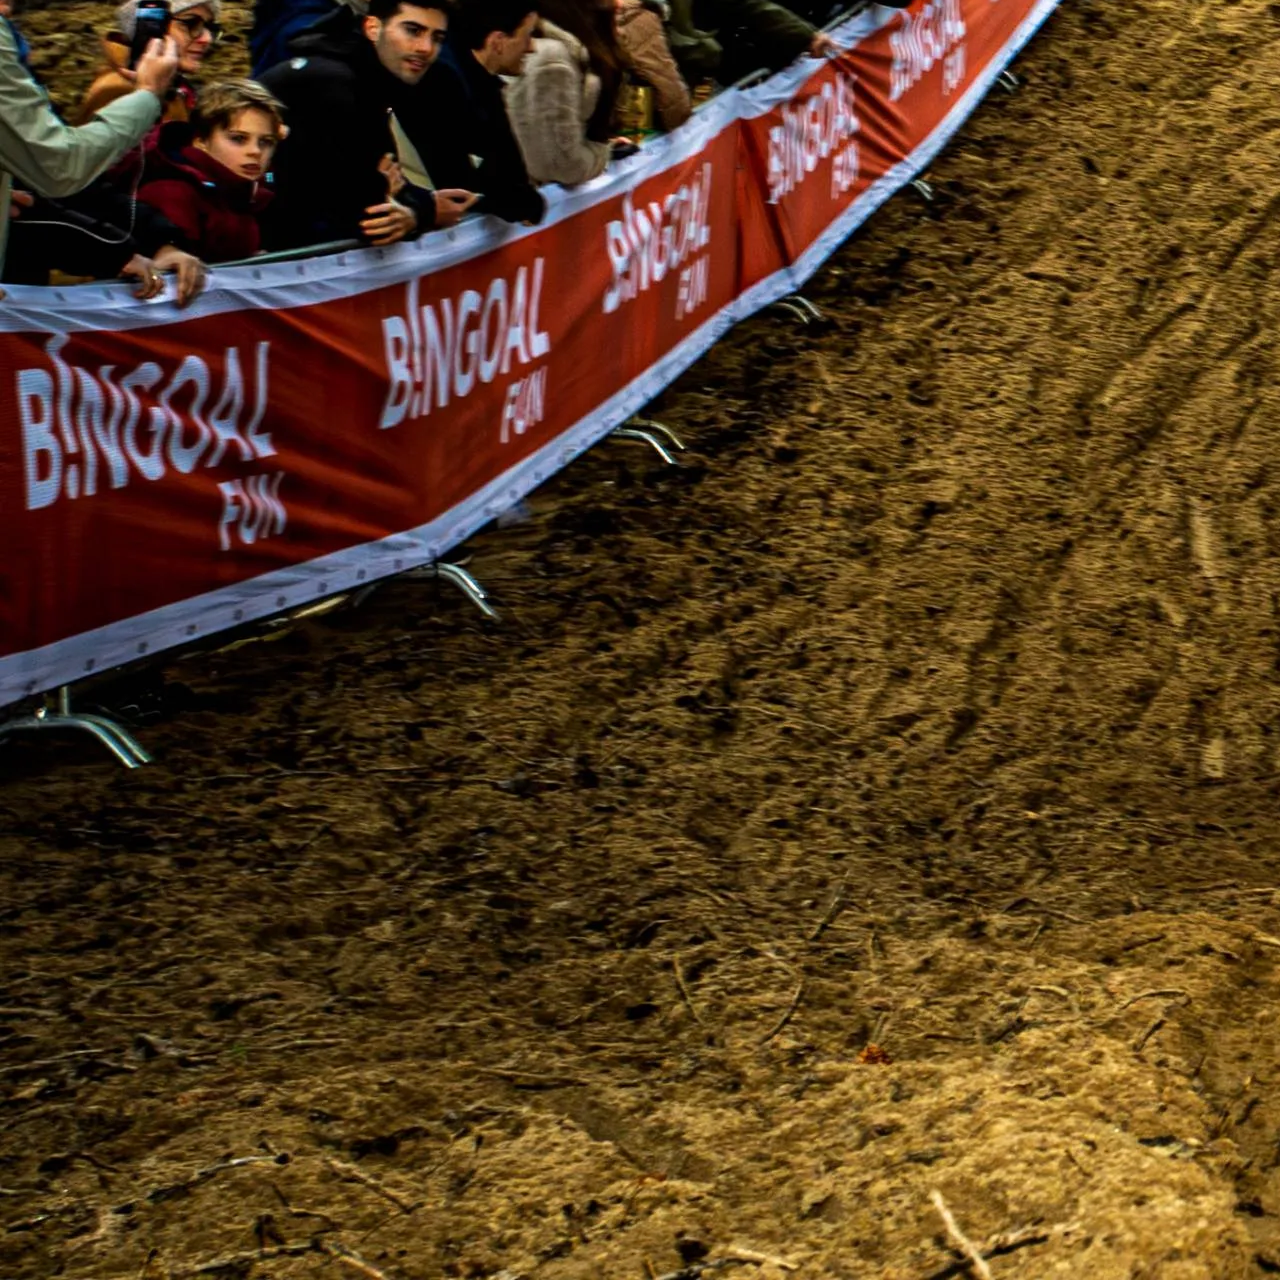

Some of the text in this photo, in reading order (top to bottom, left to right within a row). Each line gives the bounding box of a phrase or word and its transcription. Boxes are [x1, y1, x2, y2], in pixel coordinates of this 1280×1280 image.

[675, 254, 710, 321] FUN
[500, 365, 548, 444] FUN
[217, 471, 287, 551] FUN
